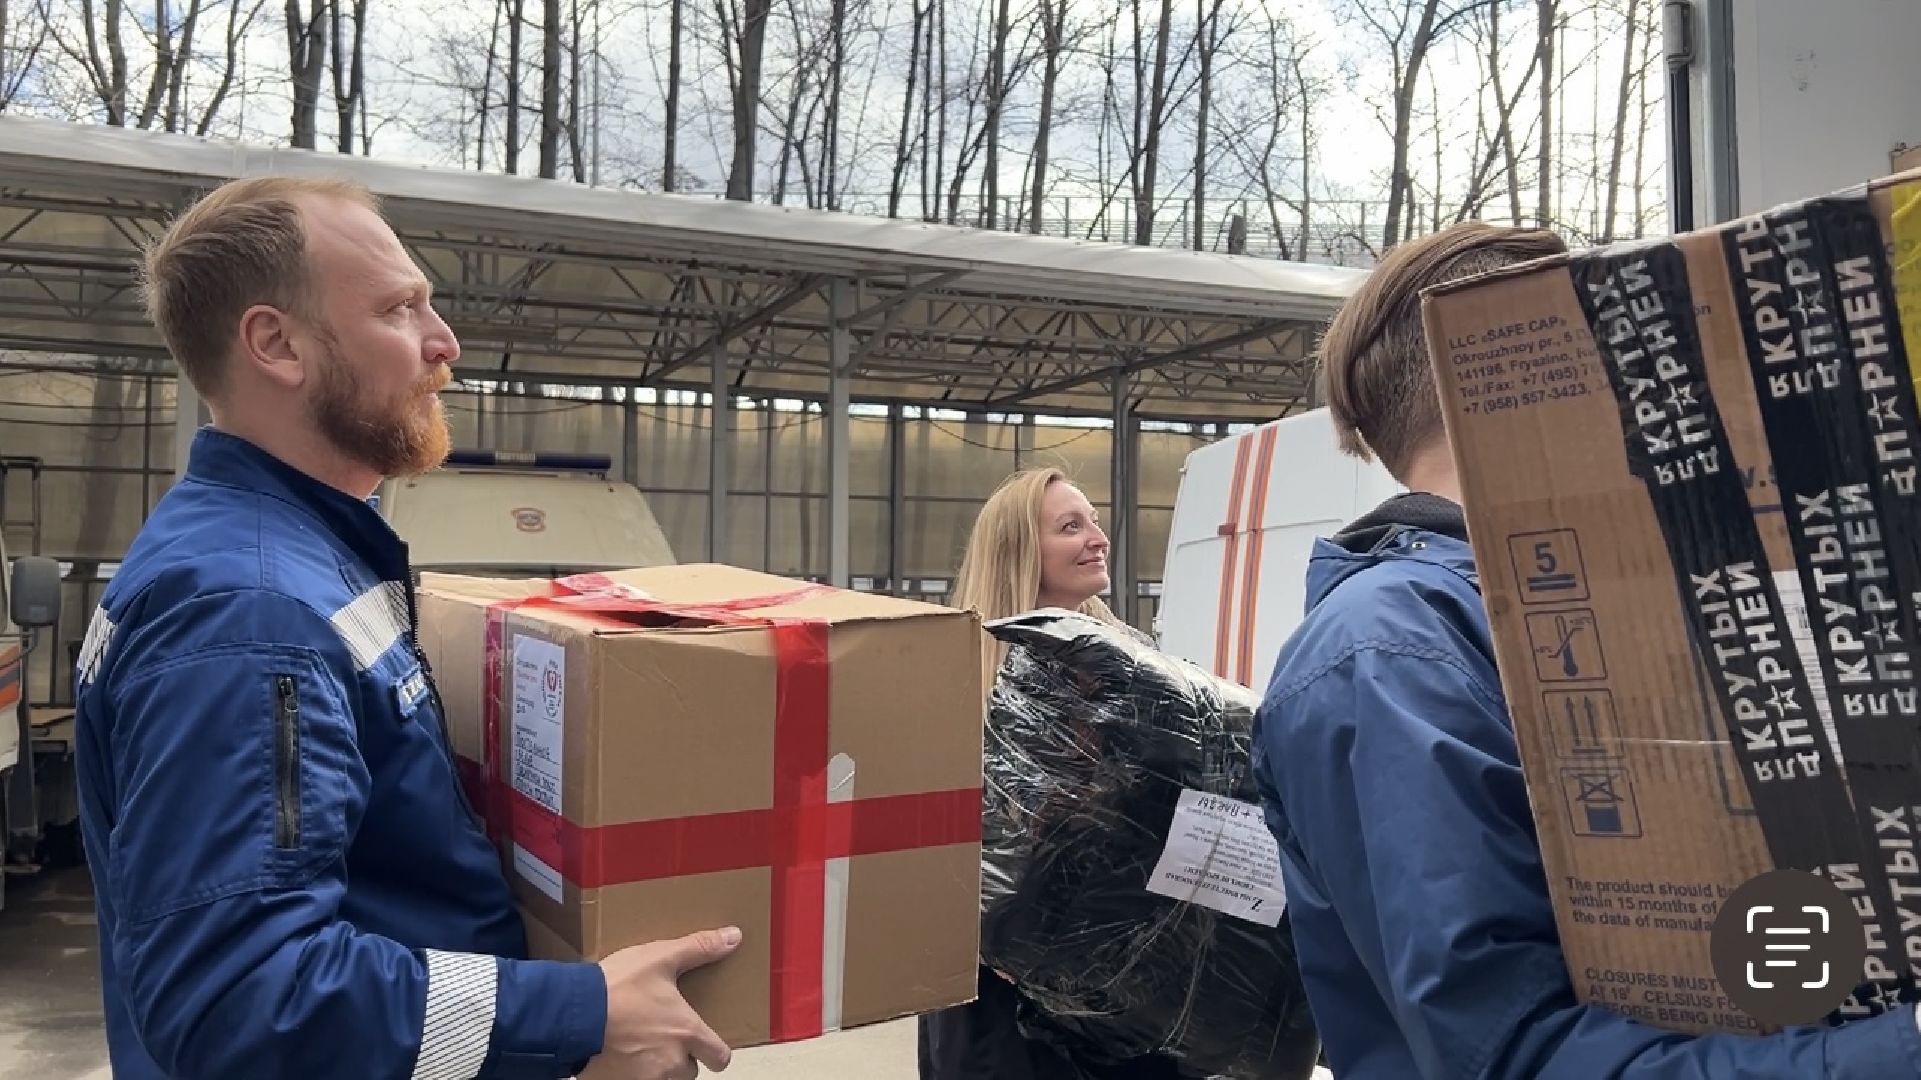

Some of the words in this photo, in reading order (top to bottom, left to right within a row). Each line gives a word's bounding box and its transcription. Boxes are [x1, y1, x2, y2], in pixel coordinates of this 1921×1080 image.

[1448, 334, 1477, 350] LLC
[1587, 273, 1679, 455] КРУТЫХ
[1521, 373, 1537, 386] +7
[1542, 366, 1579, 384] (495)
[1463, 402, 1479, 415] +7
[1534, 541, 1557, 573] 5
[1795, 489, 1873, 684] КРУТЫХ
[1690, 568, 1778, 751] КРУТЫХ
[1566, 876, 1592, 892] The
[1597, 880, 1655, 900] product
[1659, 881, 1714, 898] should
[1570, 895, 1613, 909] within
[1618, 897, 1636, 911] 15
[1639, 900, 1698, 914] months
[1701, 901, 1718, 914] of
[1573, 910, 1597, 925] the
[1599, 913, 1631, 928] date
[1635, 914, 1651, 928] of
[1585, 967, 1669, 988] CLOSURES
[1671, 975, 1718, 991] MUST
[1643, 990, 1714, 1009] CELSIUS
[1659, 1008, 1709, 1025] BEING
